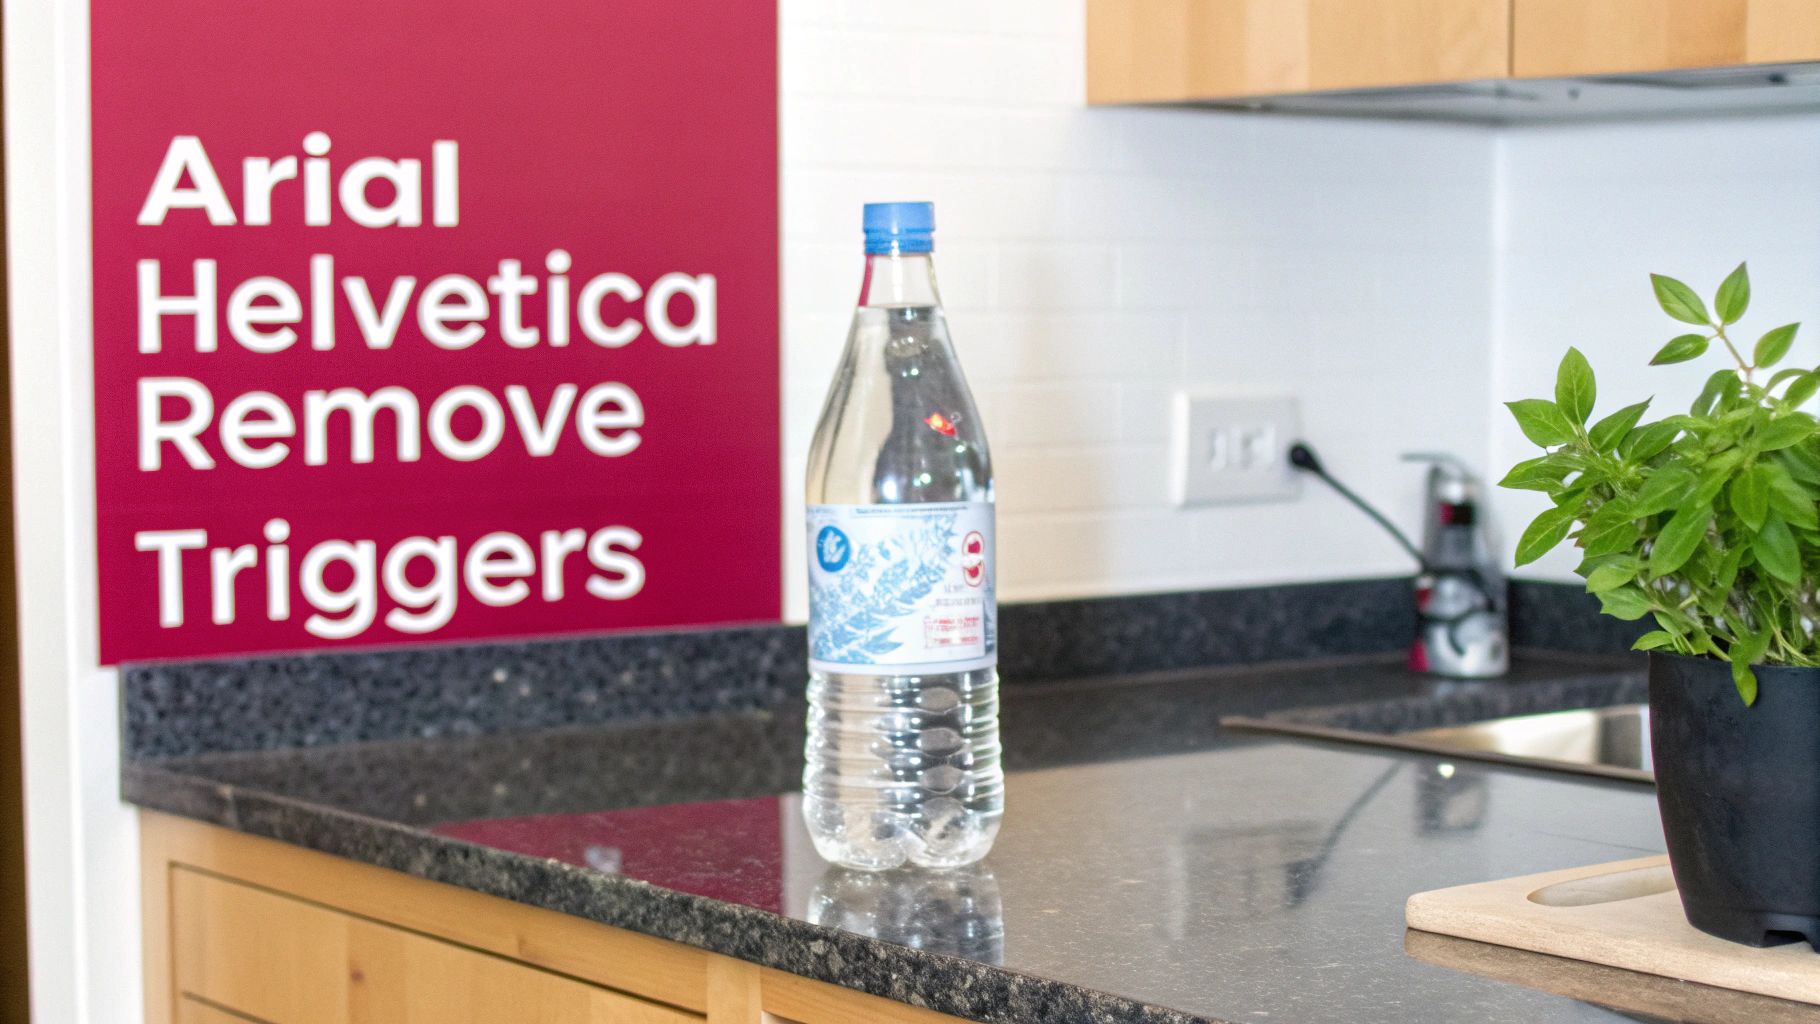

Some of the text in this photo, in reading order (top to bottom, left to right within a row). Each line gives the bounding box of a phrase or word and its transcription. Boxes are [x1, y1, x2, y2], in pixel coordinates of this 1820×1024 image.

[137, 131, 460, 229] Arial
[137, 249, 718, 354] Helvetica
[137, 377, 645, 472] Remove
[134, 519, 646, 640] Triggers
